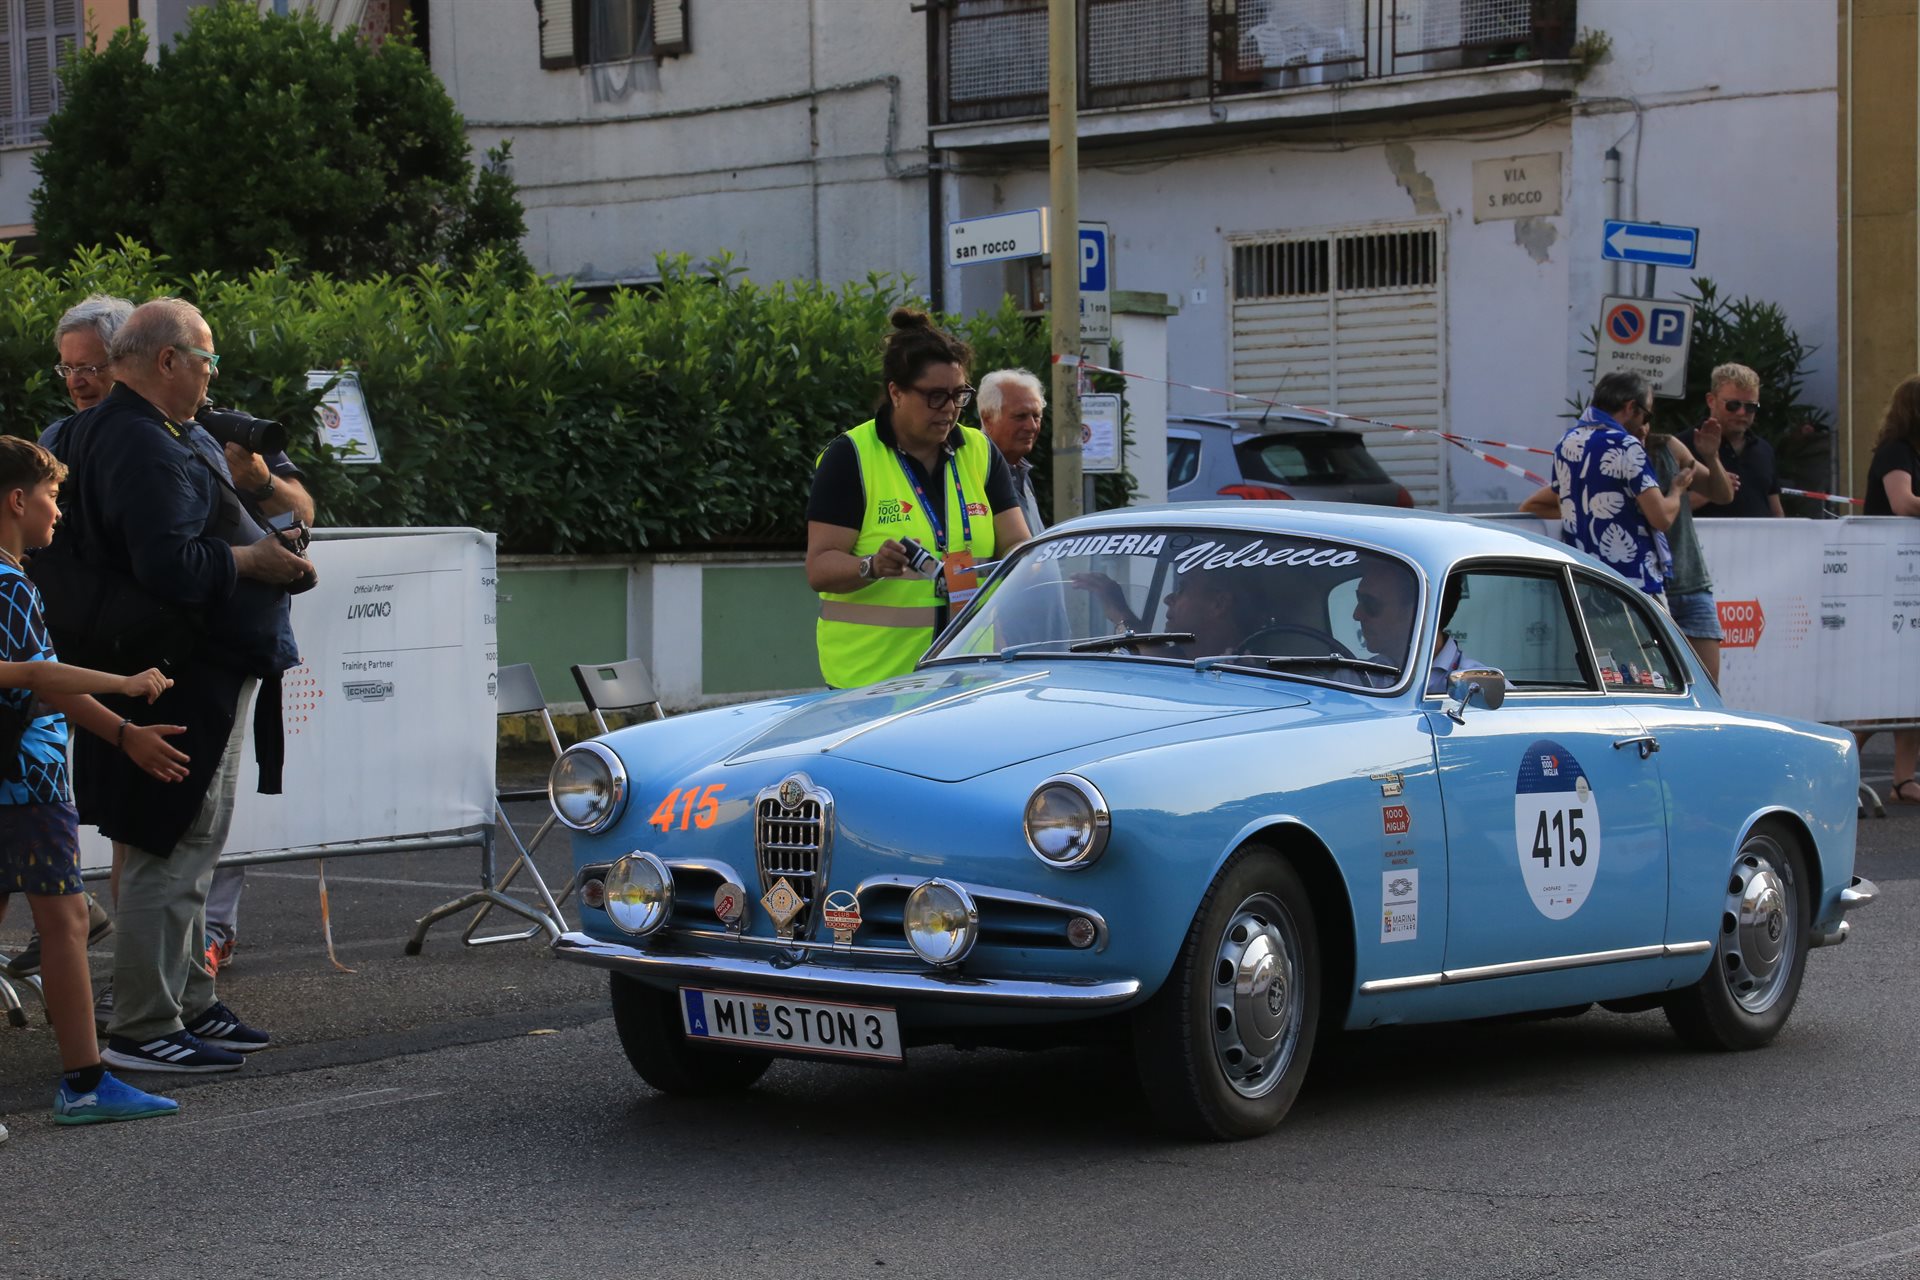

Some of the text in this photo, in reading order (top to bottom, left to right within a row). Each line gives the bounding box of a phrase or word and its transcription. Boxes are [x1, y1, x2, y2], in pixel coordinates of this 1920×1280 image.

[1503, 168, 1527, 182] VIA
[1502, 190, 1543, 206] ROCCO
[955, 226, 965, 235] via
[956, 239, 1016, 259] san rocco
[1612, 351, 1672, 364] parcheggio
[878, 503, 900, 516] 1000
[1036, 534, 1360, 574] SCUDERIA Velsecco
[354, 583, 394, 594] Official Partner
[347, 601, 392, 619] LIVIGNO
[1721, 606, 1754, 622] 1000
[342, 660, 394, 671] Training Partner
[648, 783, 727, 832] 415
[1386, 808, 1403, 819] 1000
[1386, 821, 1406, 831] MIGLIA
[1532, 808, 1587, 868] 415
[1393, 914, 1416, 923] MARINA
[1392, 924, 1416, 932] MILITARE
[694, 1018, 704, 1030] A
[713, 998, 884, 1050] MI STON 3
